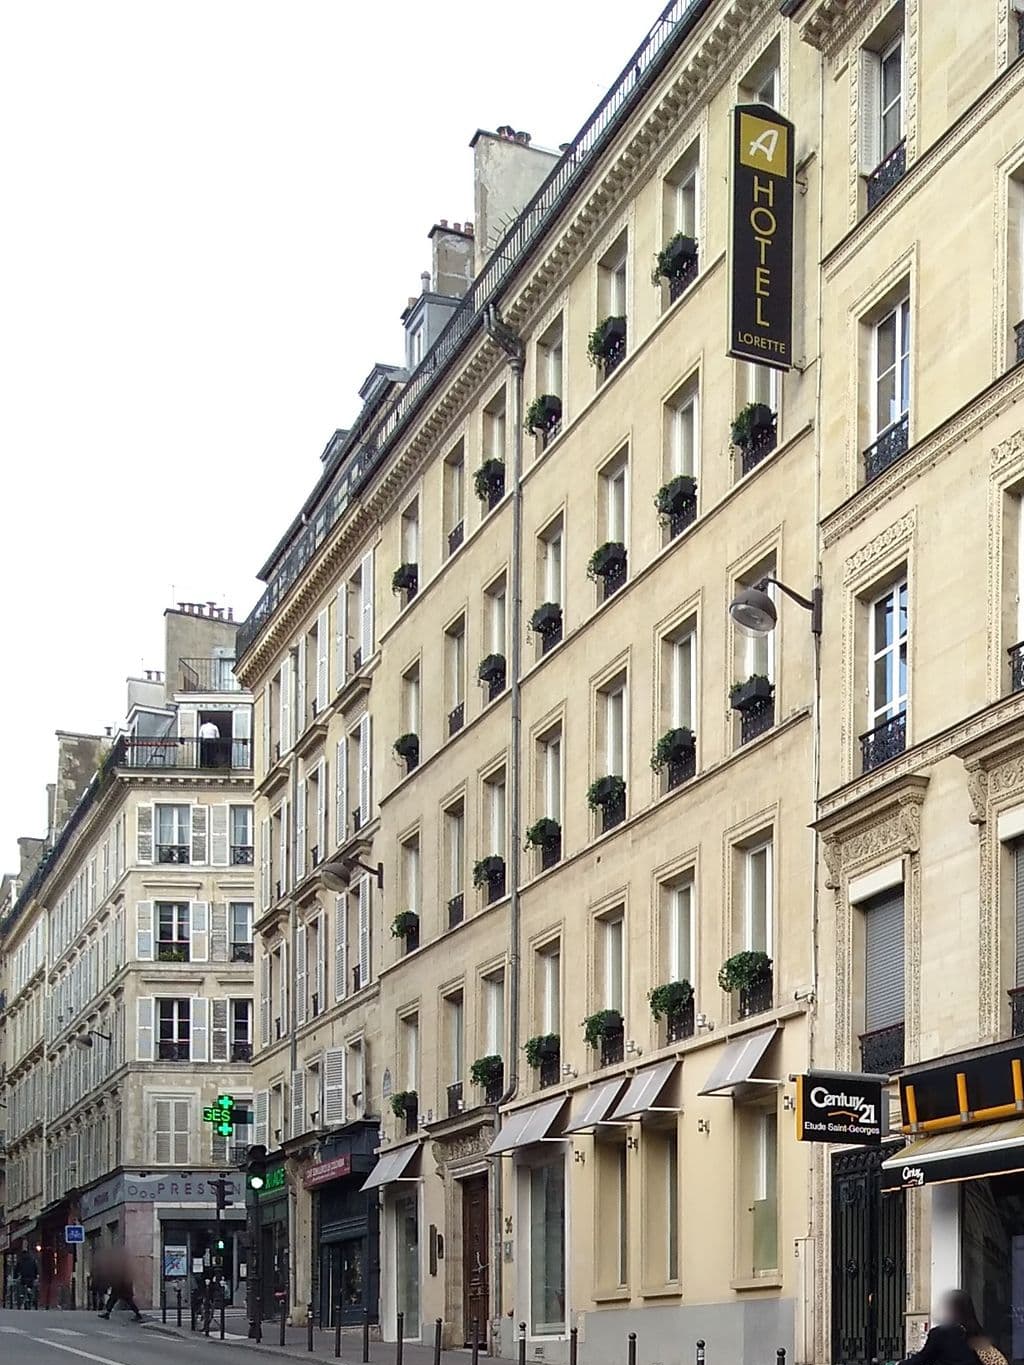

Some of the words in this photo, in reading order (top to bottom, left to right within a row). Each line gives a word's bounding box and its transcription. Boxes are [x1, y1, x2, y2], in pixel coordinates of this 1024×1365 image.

[749, 129, 778, 163] A
[750, 175, 777, 328] HOTEL
[738, 331, 786, 354] LORETTE
[810, 1086, 865, 1111] Century
[858, 1103, 876, 1124] 21
[804, 1121, 827, 1131] Etude
[827, 1122, 880, 1136] Saint-Georges
